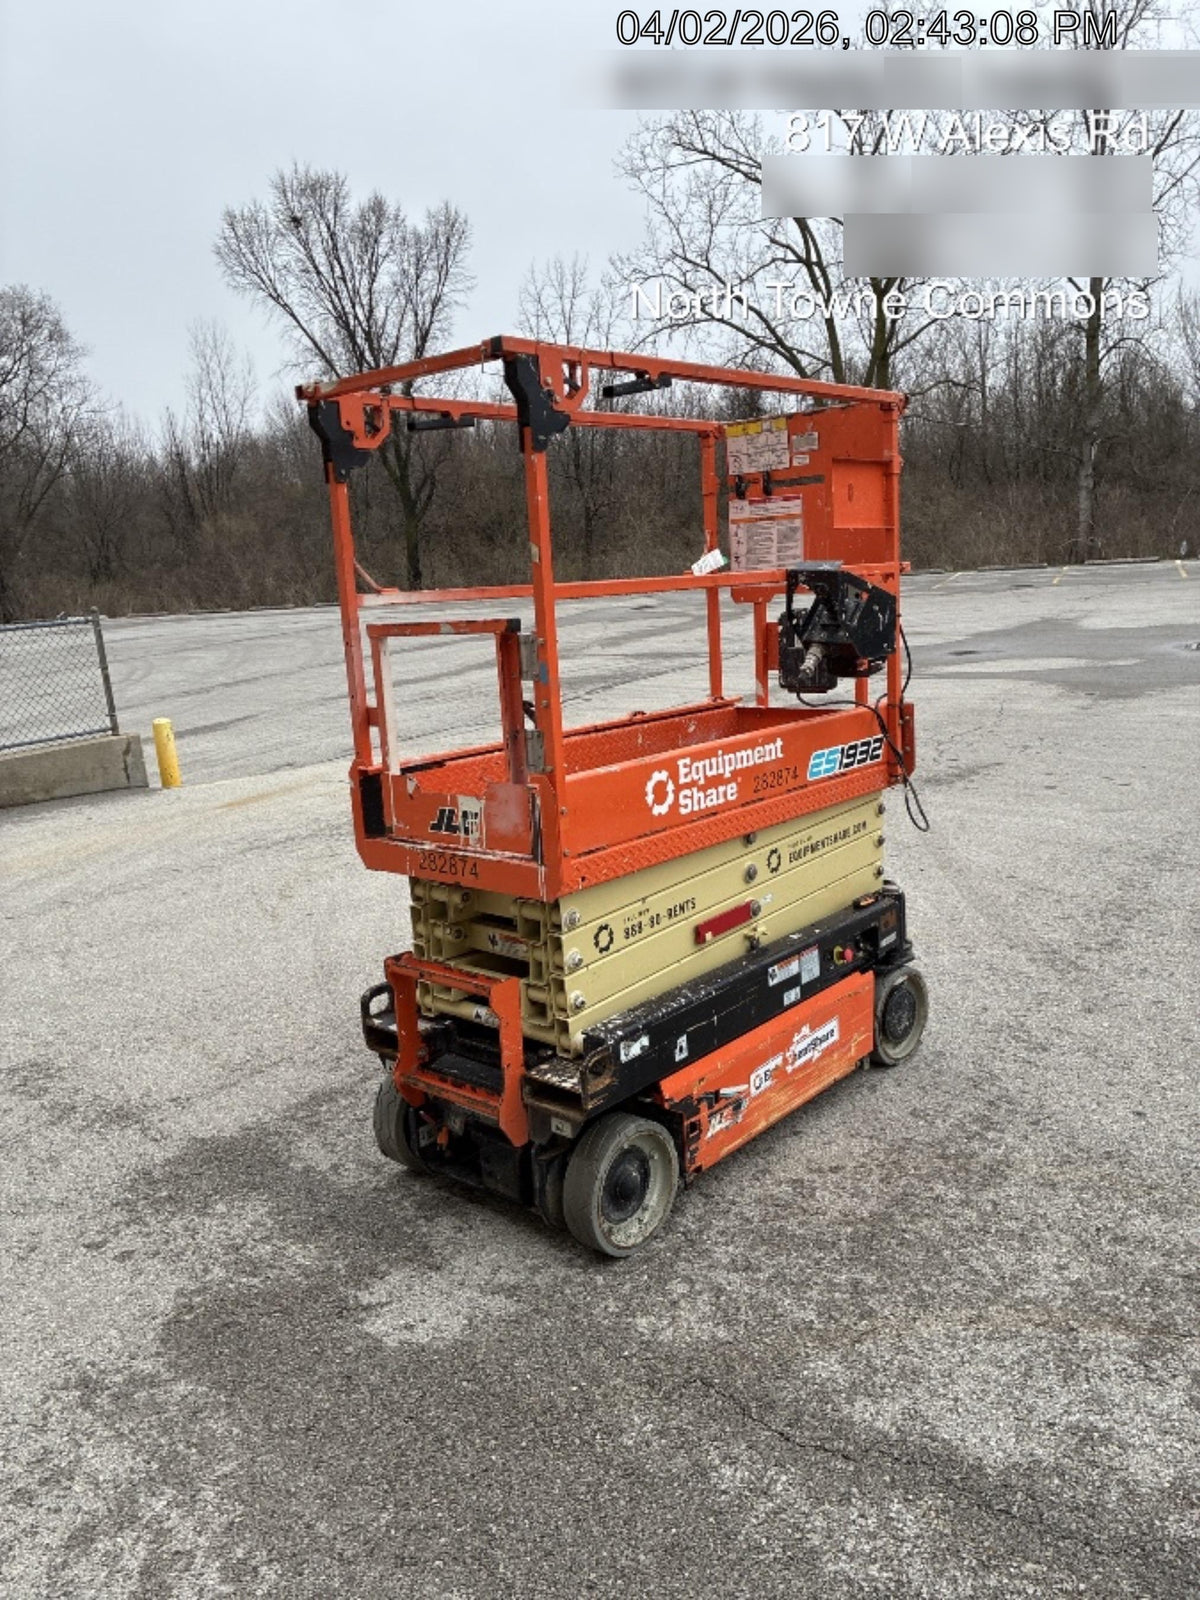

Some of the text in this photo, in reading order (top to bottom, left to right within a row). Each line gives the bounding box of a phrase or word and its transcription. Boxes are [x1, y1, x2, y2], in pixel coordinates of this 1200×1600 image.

[677, 737, 784, 784] Equipment
[808, 735, 884, 779] ES1932
[678, 781, 738, 815] Share
[753, 766, 799, 793] 282874
